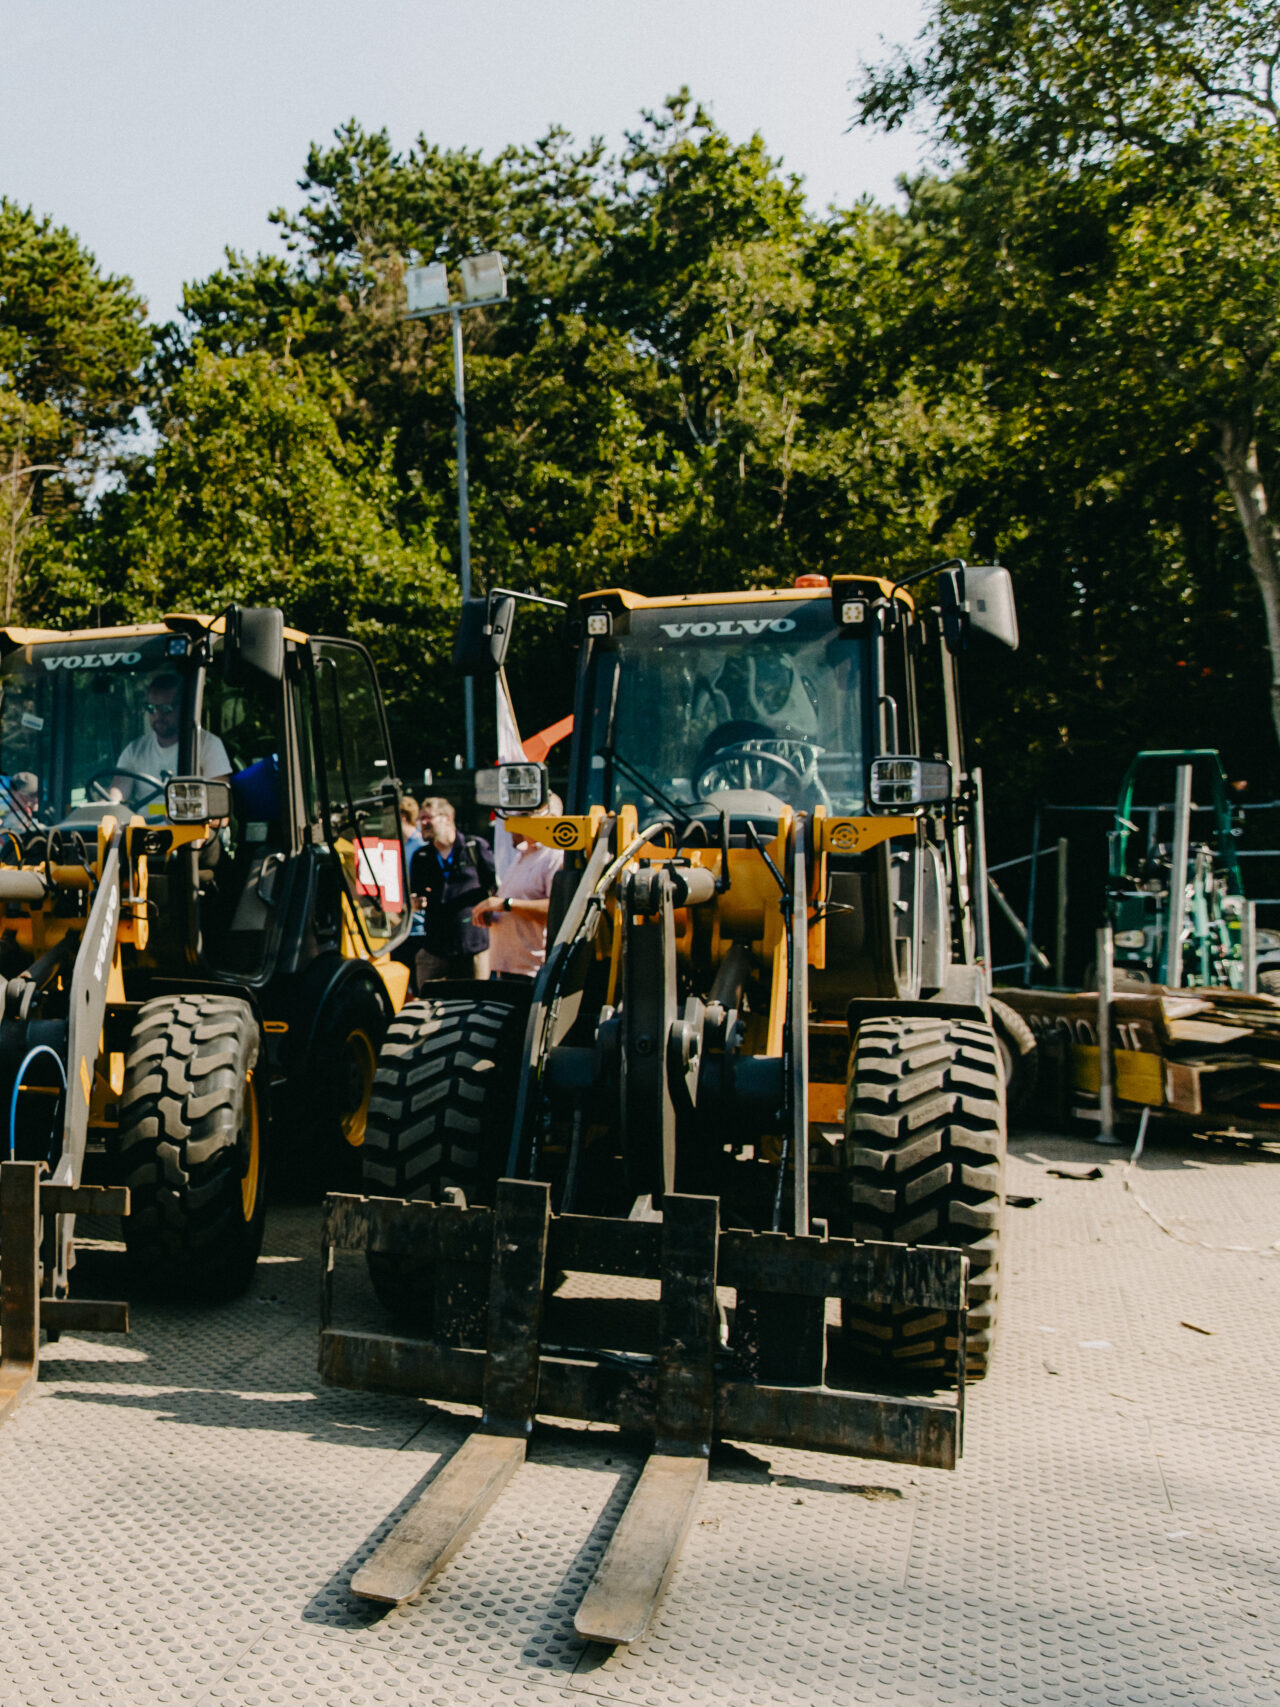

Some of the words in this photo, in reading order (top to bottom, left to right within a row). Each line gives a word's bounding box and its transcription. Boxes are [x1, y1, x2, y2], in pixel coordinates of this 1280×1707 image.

[659, 618, 797, 639] VOLVO
[41, 651, 142, 671] VOLVO
[93, 884, 118, 982] VOLVO
